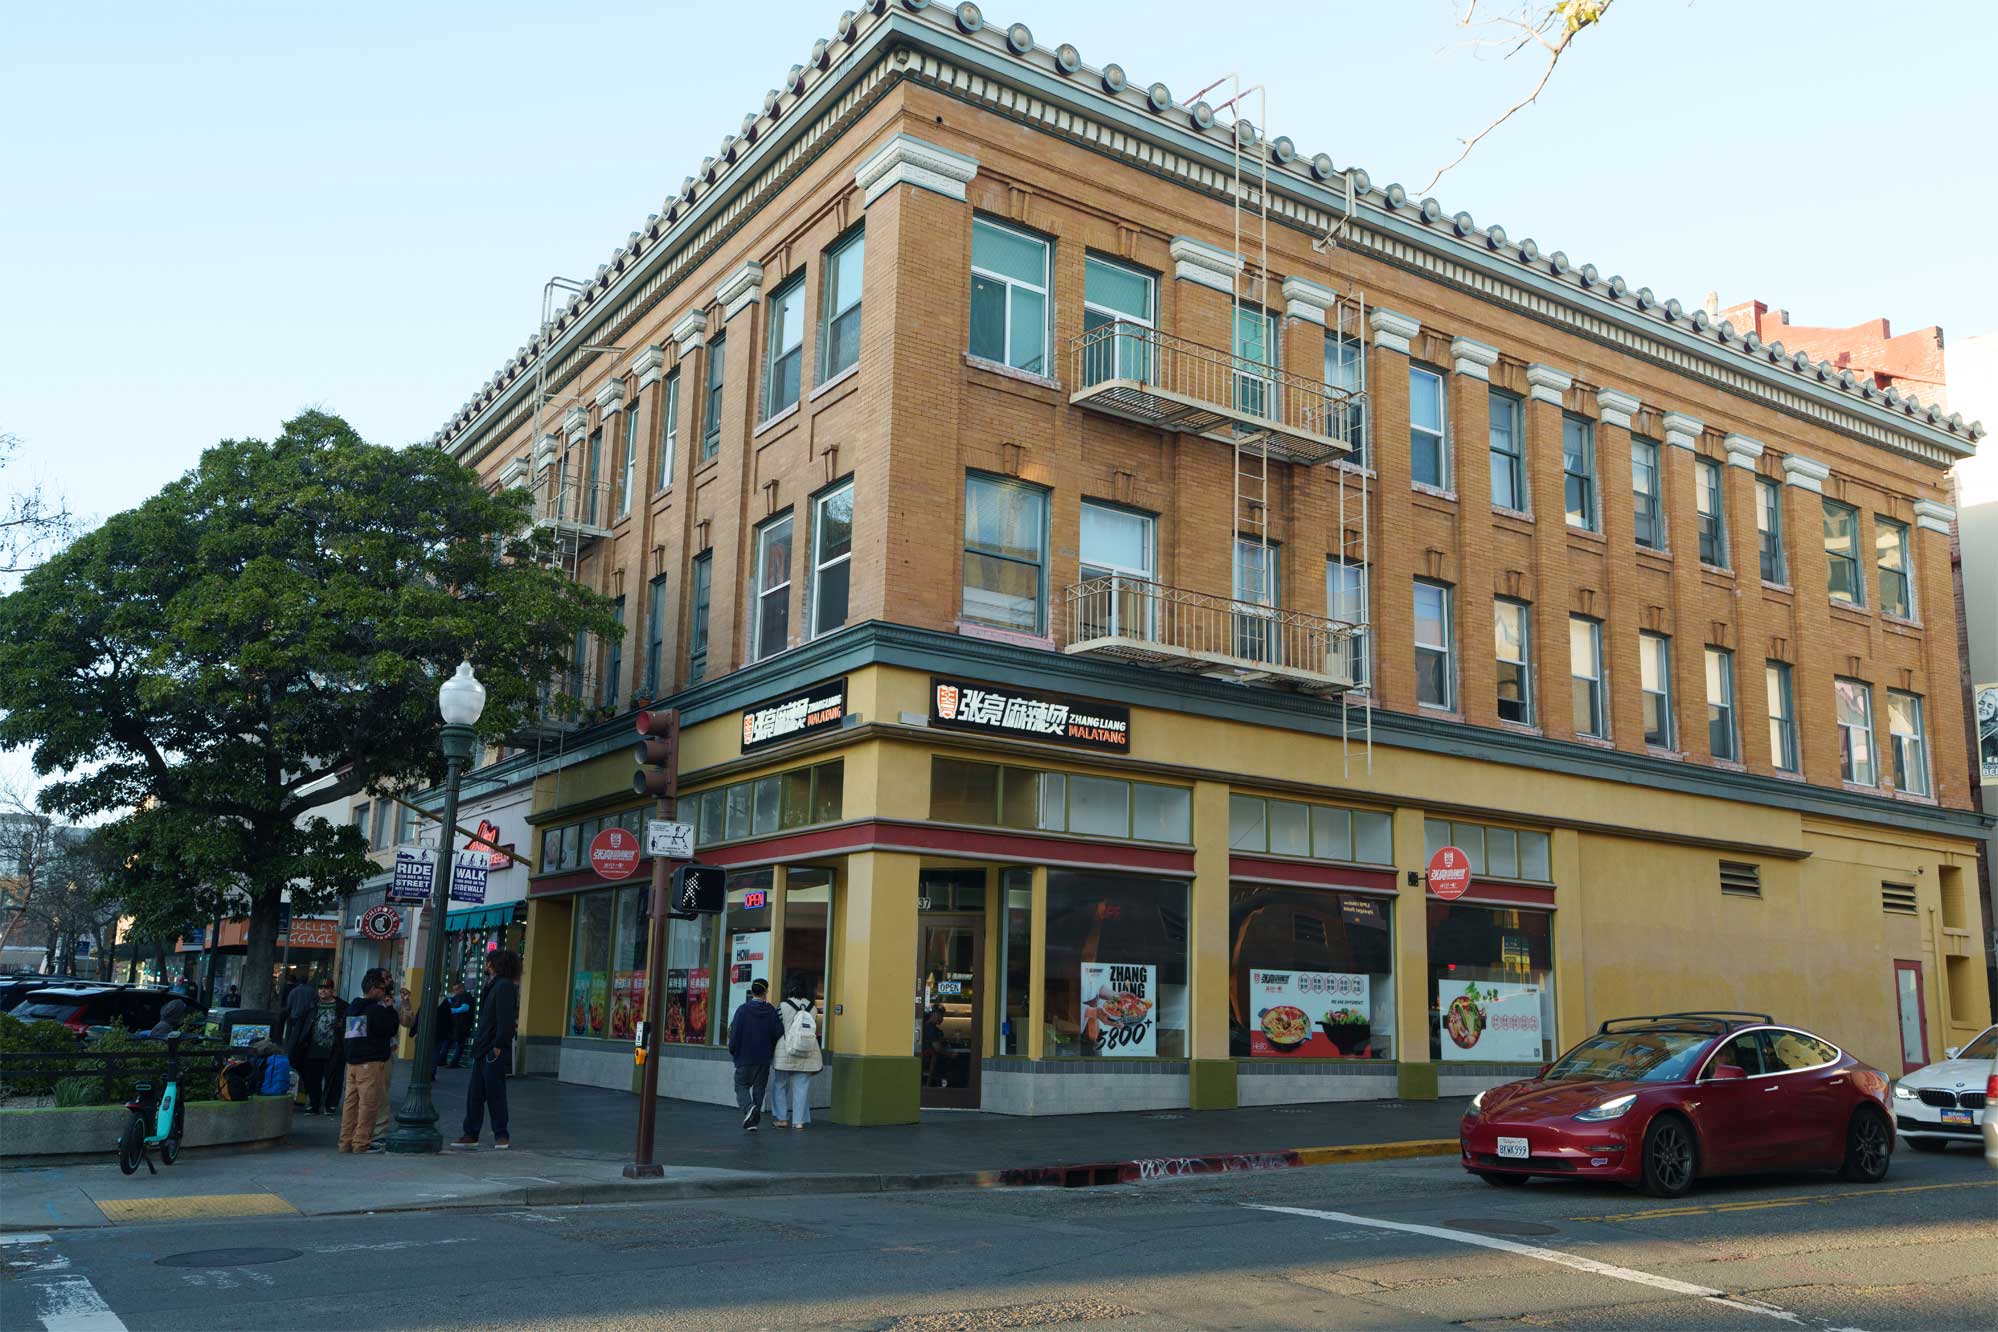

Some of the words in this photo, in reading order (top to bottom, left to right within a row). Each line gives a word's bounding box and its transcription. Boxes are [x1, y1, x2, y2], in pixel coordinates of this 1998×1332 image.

[807, 706, 841, 727] MALATANG
[1068, 724, 1126, 744] MALATANG
[396, 863, 432, 875] RIDE
[456, 868, 487, 881] WALK
[395, 879, 431, 888] STREET
[453, 884, 485, 893] SIDEWALK
[745, 892, 763, 908] OPEN
[365, 906, 399, 921] CHIPOTLE
[1110, 966, 1148, 983] ZHANG
[940, 983, 960, 992] OPEN
[1499, 1144, 1527, 1156] 8KWK999
